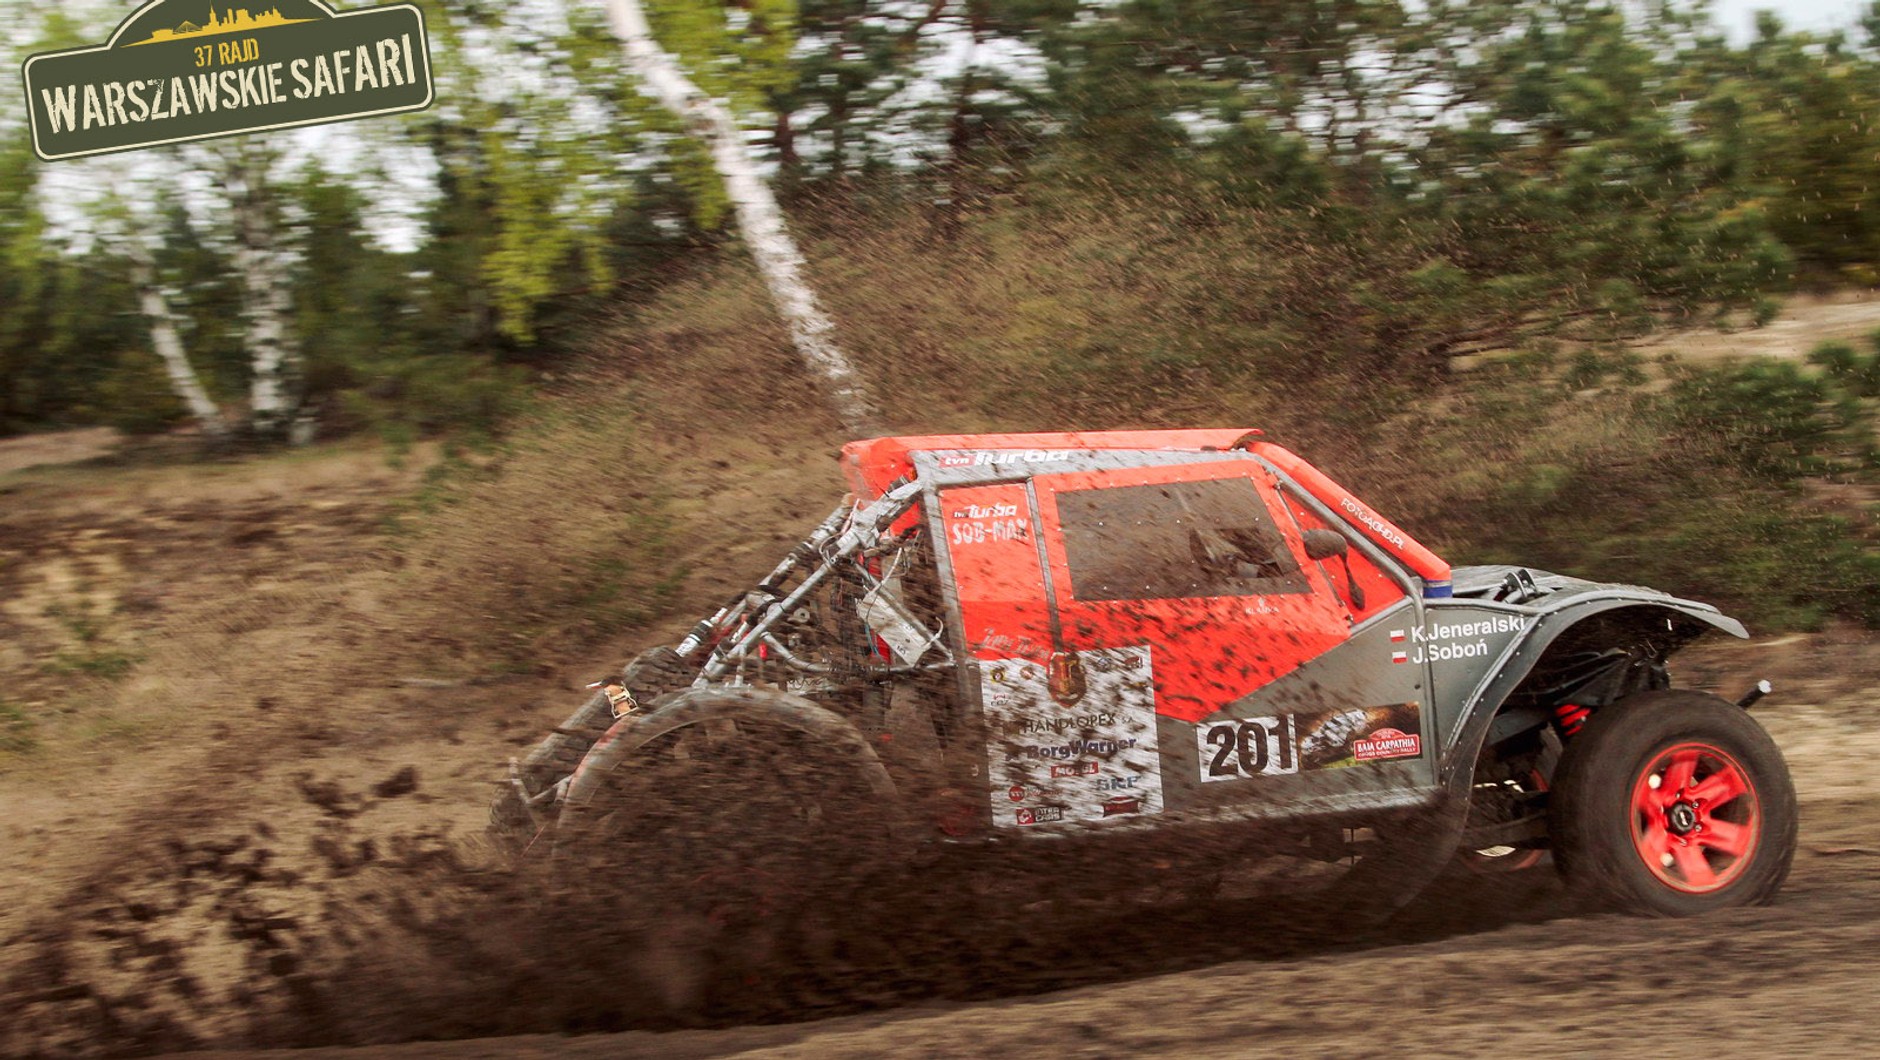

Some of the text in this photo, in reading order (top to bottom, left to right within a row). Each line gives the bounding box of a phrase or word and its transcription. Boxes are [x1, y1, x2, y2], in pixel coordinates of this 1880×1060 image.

[945, 456, 969, 465] tvn
[953, 519, 1028, 544] SOB-MAX
[1411, 615, 1525, 643] K.Jeneralski
[1412, 640, 1488, 664] J.Soboń
[1024, 713, 1116, 734] HANDLOPEX
[1026, 738, 1137, 759] BorgWarner
[1206, 714, 1292, 776] 201
[1376, 738, 1416, 750] CARPATHIA
